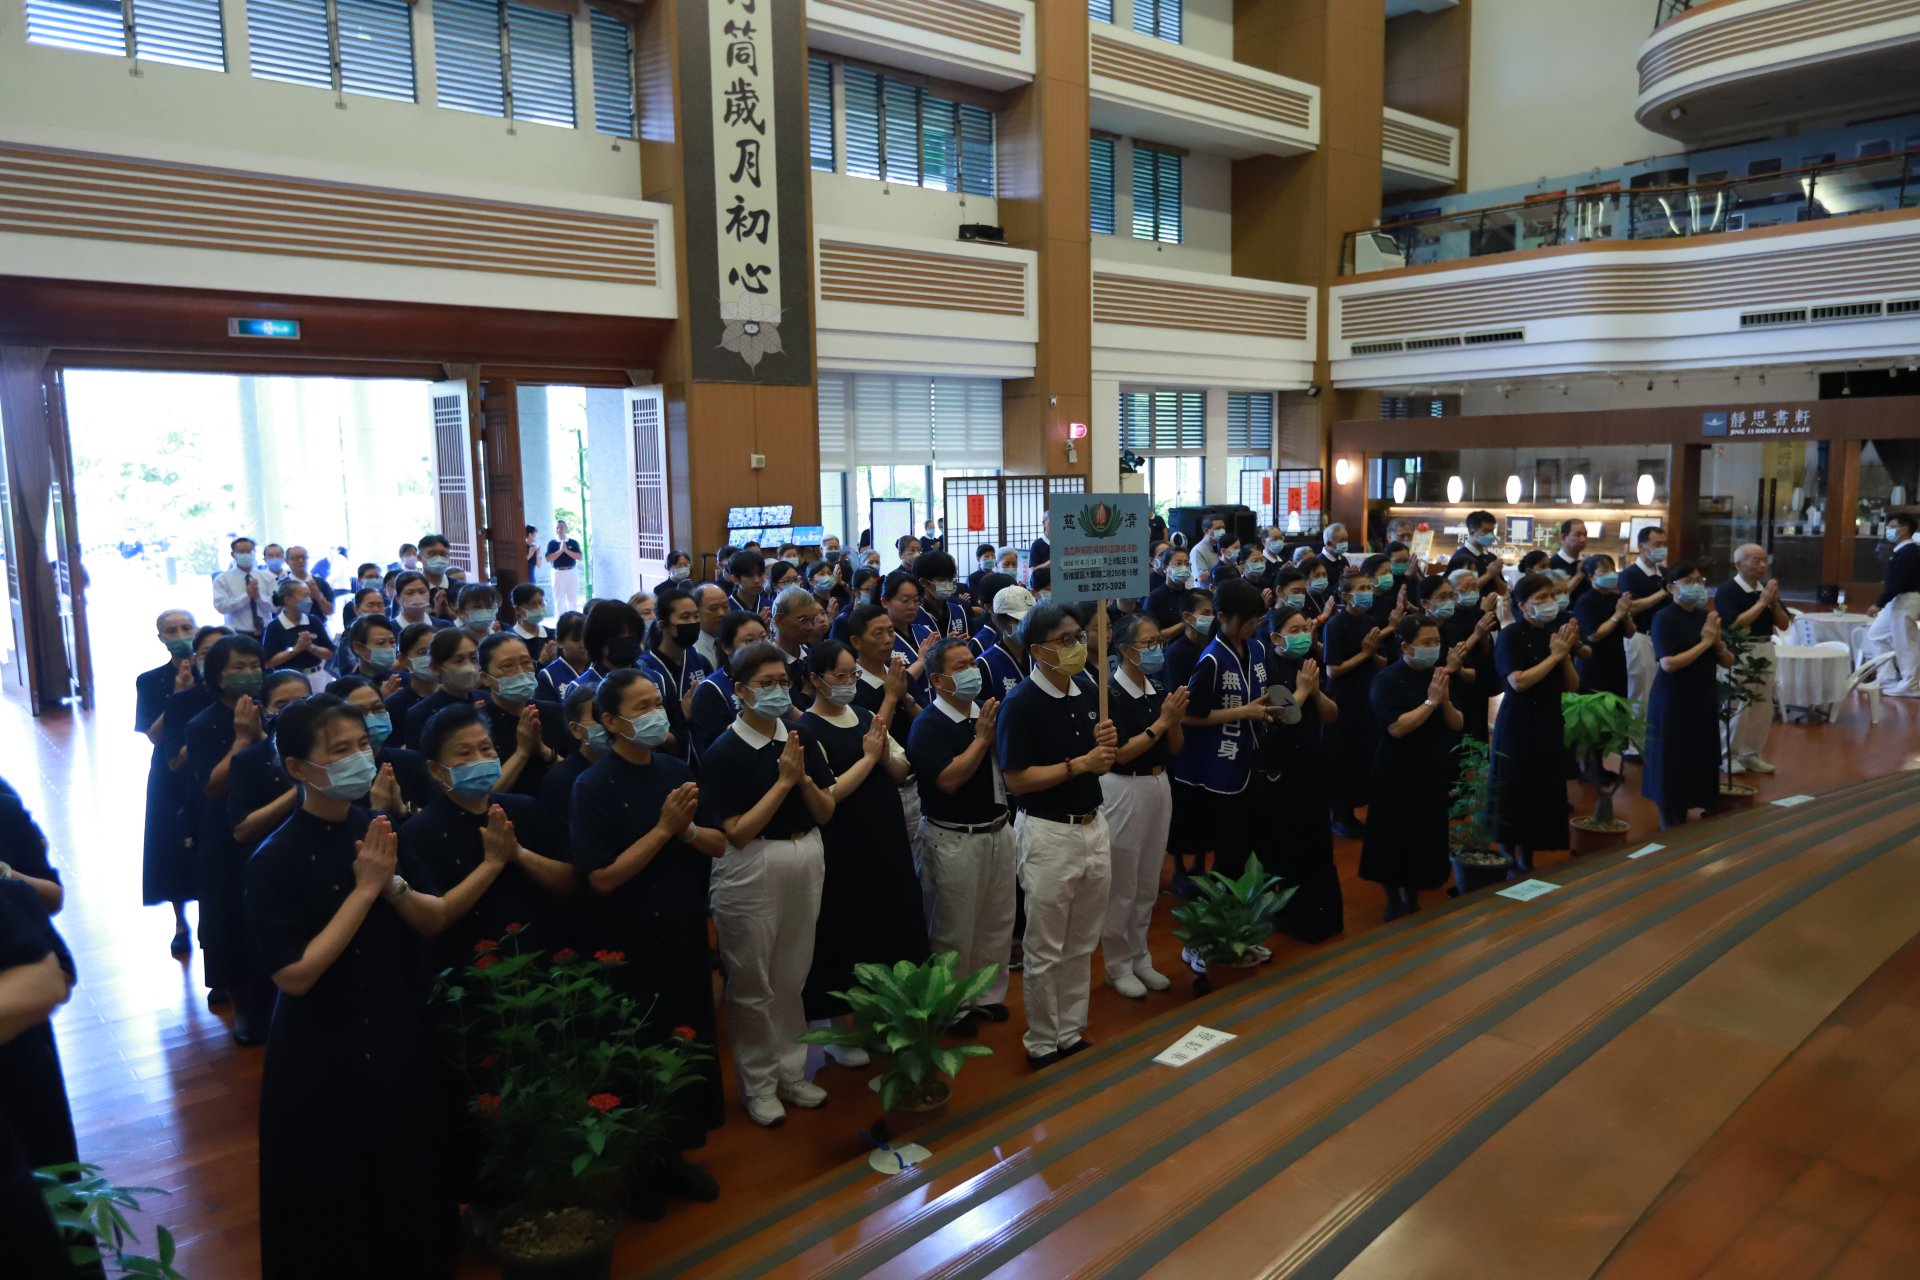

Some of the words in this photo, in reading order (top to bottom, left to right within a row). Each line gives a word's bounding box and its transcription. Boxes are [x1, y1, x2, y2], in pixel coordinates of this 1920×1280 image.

[723, 0, 772, 295] 筒歲月初心
[1730, 409, 1811, 428] 靜思書軒
[1062, 513, 1076, 530] 慈
[1125, 513, 1137, 528] 濟
